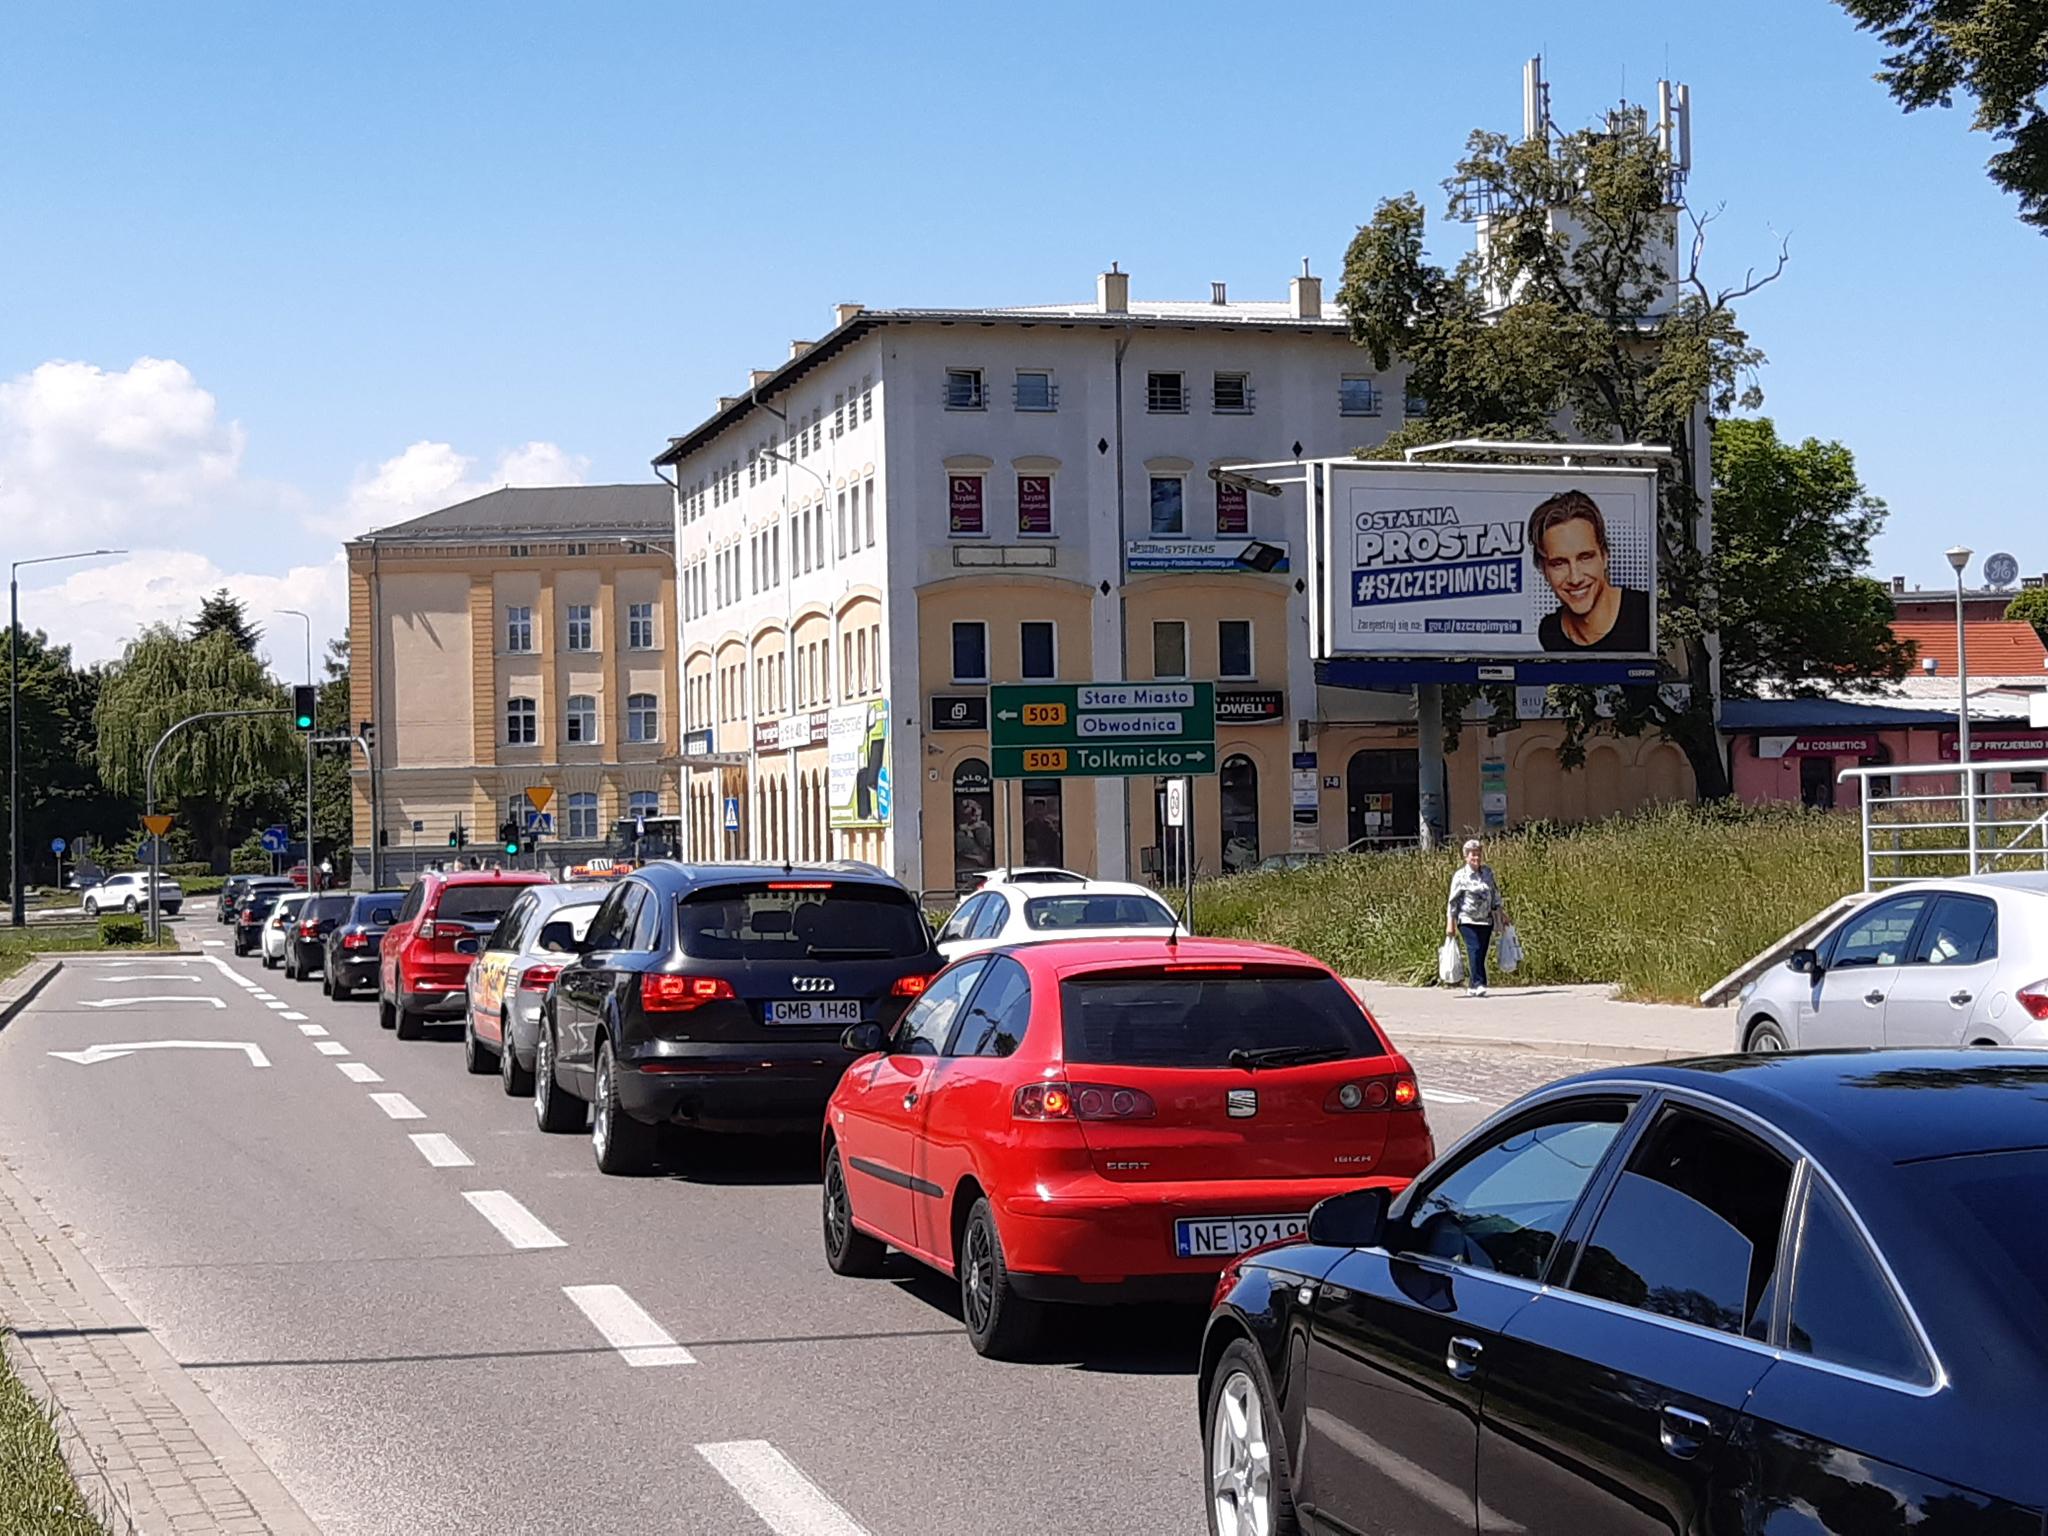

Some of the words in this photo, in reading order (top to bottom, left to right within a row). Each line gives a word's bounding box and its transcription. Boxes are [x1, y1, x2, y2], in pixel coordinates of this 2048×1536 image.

[1356, 506, 1460, 531] OSTATNIA
[1355, 521, 1525, 567] PROSTA!
[1357, 563, 1518, 602] #SZCZEPIMYSIĘ
[1084, 690, 1128, 706] Stare
[1134, 689, 1189, 704] Miasto
[1028, 707, 1061, 722] 503
[1083, 717, 1176, 733] Obwodnica
[1812, 741, 1867, 751] COSMETICS
[1029, 752, 1062, 767] 503
[1077, 748, 1182, 769] Tolkmicko
[775, 1002, 812, 1019] GMB
[820, 1001, 858, 1018] 1H48
[1195, 1225, 1228, 1252] NE
[1239, 1222, 1306, 1250] 3919
